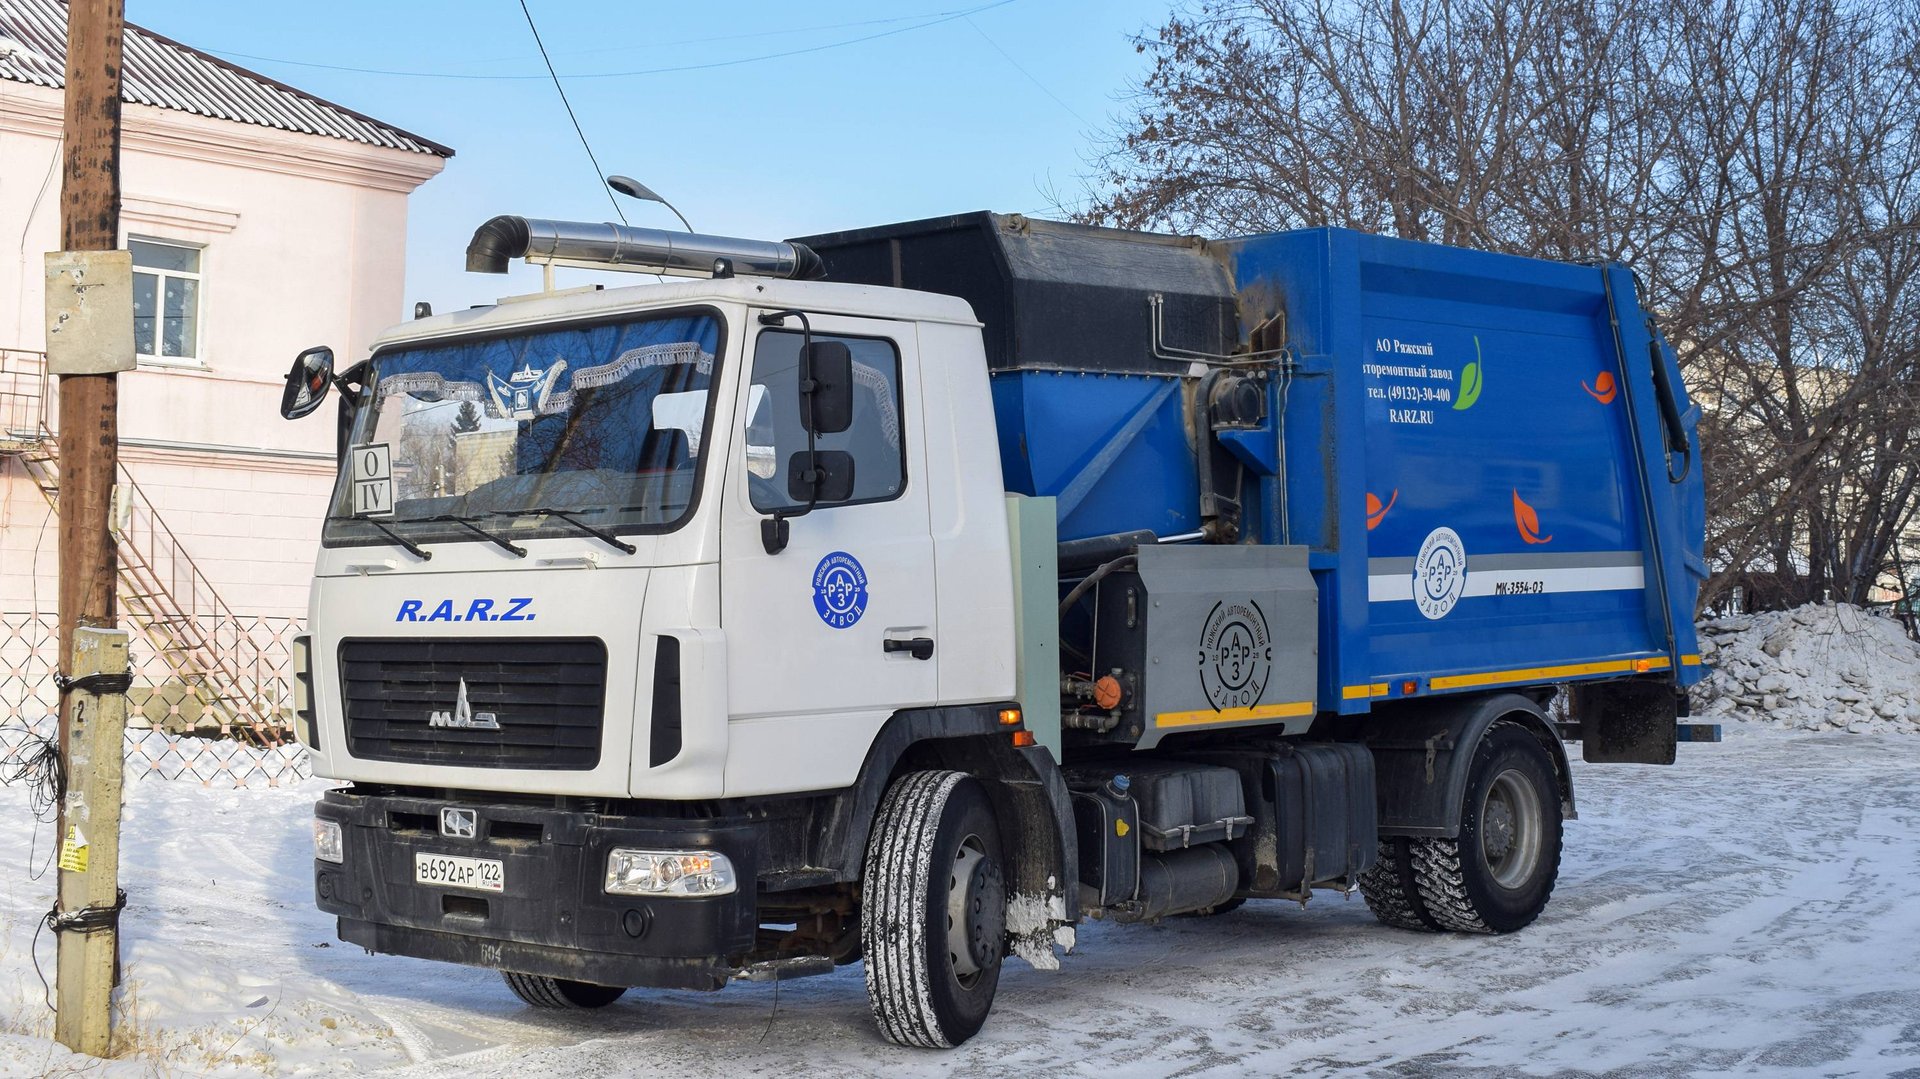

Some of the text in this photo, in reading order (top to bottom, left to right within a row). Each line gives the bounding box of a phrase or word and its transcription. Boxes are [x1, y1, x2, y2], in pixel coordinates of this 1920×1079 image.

[1376, 338, 1434, 356] АО Ряжский
[1429, 368, 1453, 381] завод
[1367, 385, 1451, 403] тел. (49132)-30-400
[1389, 408, 1434, 424] RARZ.RU
[362, 483, 383, 510] IV
[396, 598, 537, 622] R.A.R.Z.
[823, 605, 863, 626] ЗАВОД
[1420, 592, 1456, 616] ЗАВОД
[429, 676, 501, 730] МАЗ
[1213, 679, 1260, 708] ЗАВОД
[421, 858, 500, 884] В692АР 122
